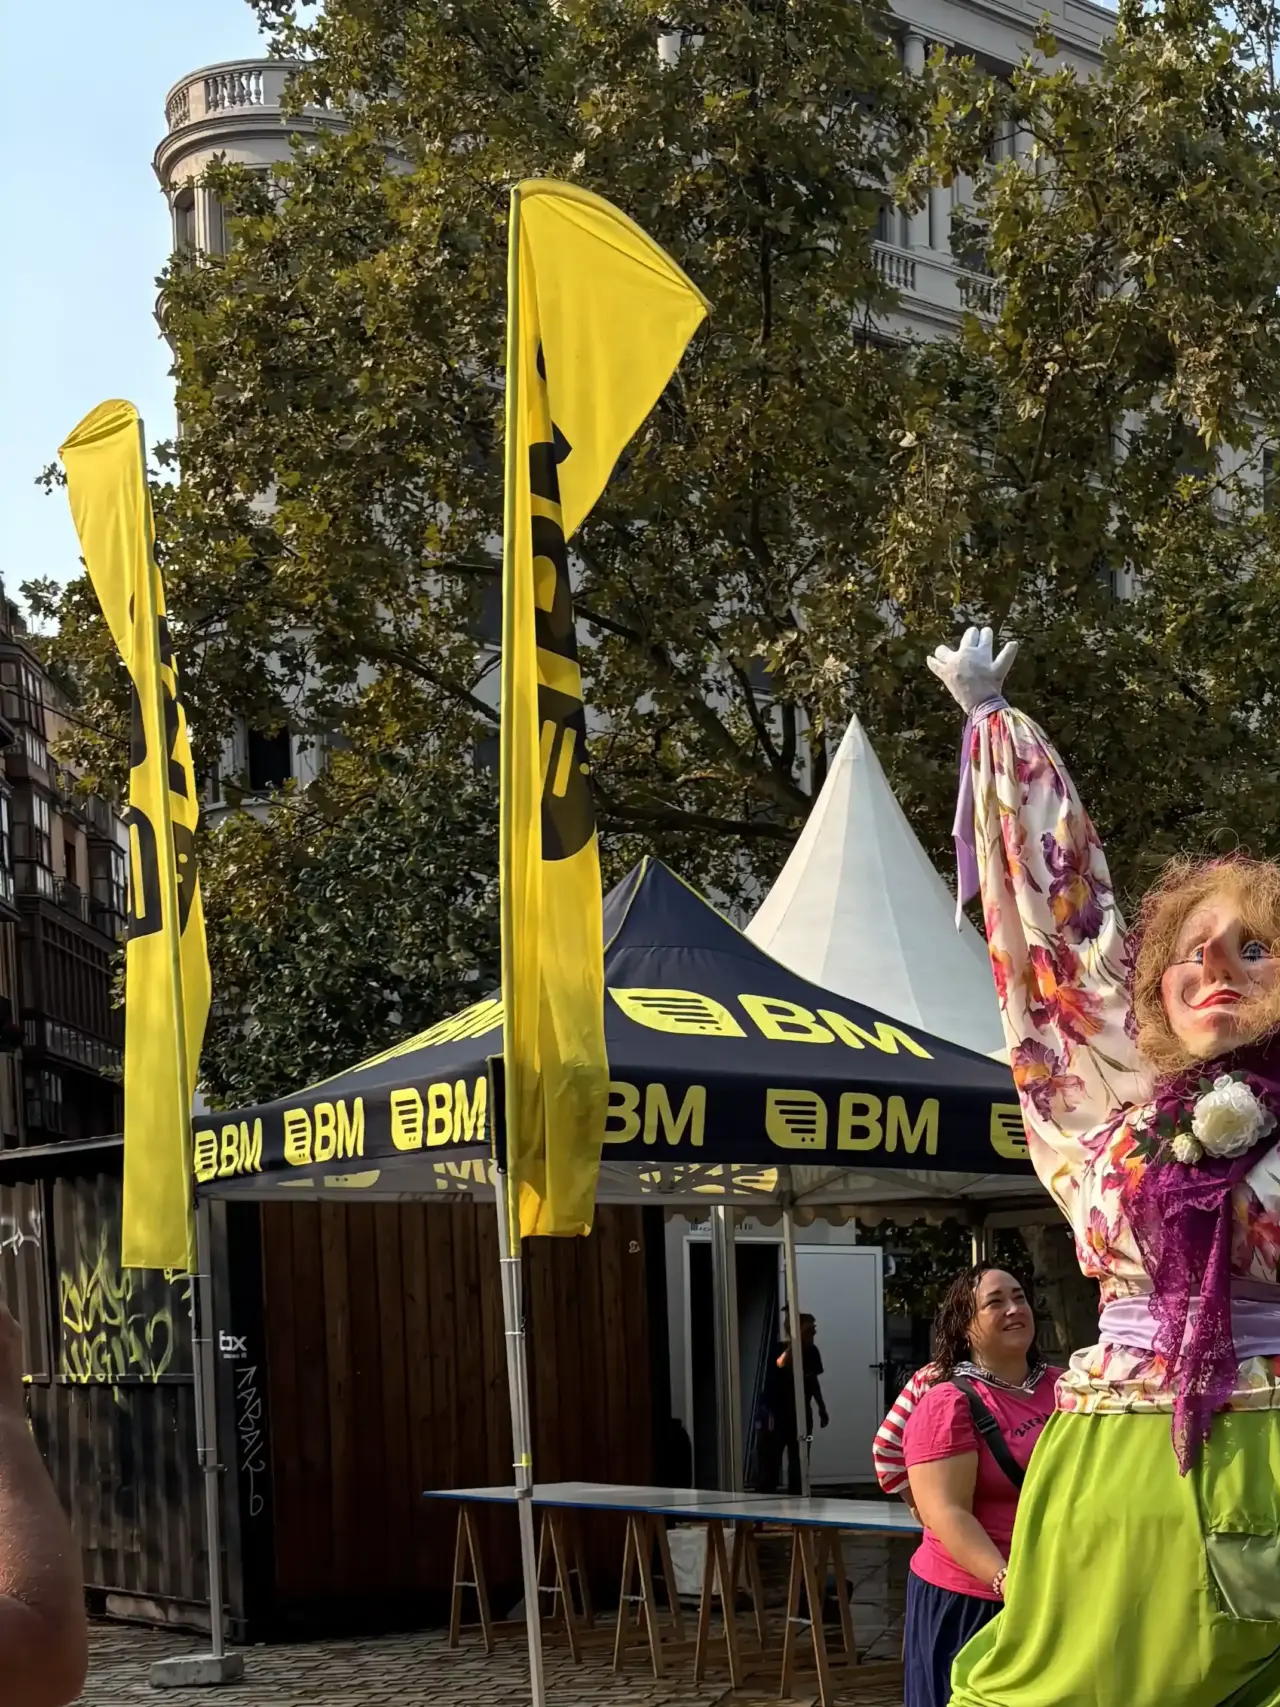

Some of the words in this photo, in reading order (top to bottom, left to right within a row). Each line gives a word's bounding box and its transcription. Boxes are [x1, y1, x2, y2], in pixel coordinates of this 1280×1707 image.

[737, 993, 935, 1060] BM
[314, 1096, 364, 1162] BM
[426, 1076, 487, 1147] BM
[603, 1081, 707, 1147] BM
[837, 1092, 939, 1155] BM
[217, 1118, 263, 1177] BM
